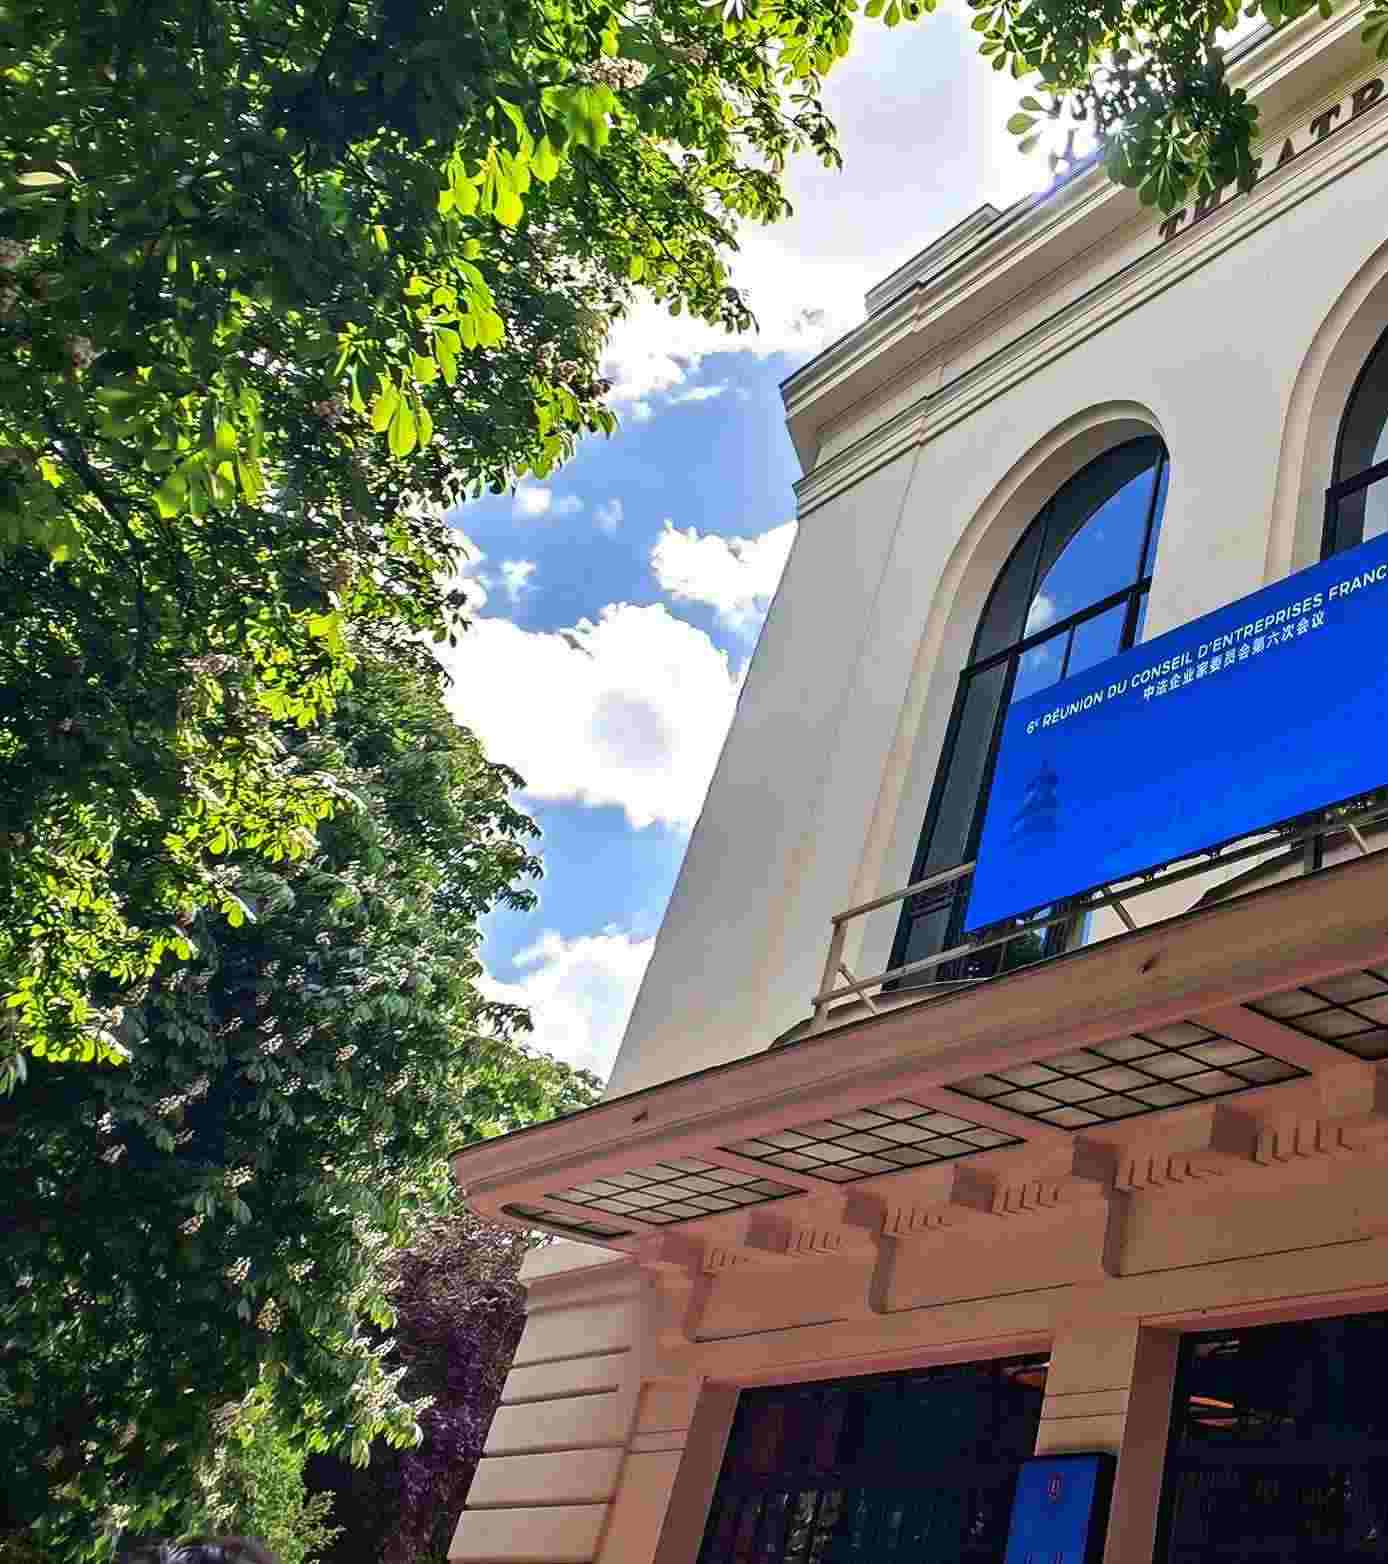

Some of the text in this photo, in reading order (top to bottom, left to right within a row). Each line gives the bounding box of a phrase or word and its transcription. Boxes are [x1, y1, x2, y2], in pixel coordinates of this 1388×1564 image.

[1042, 690, 1104, 728] RÉUNION
[1107, 680, 1128, 699] DU
[1131, 651, 1193, 688] CONSEIL
[1198, 593, 1324, 658] D'ENTREPRISES
